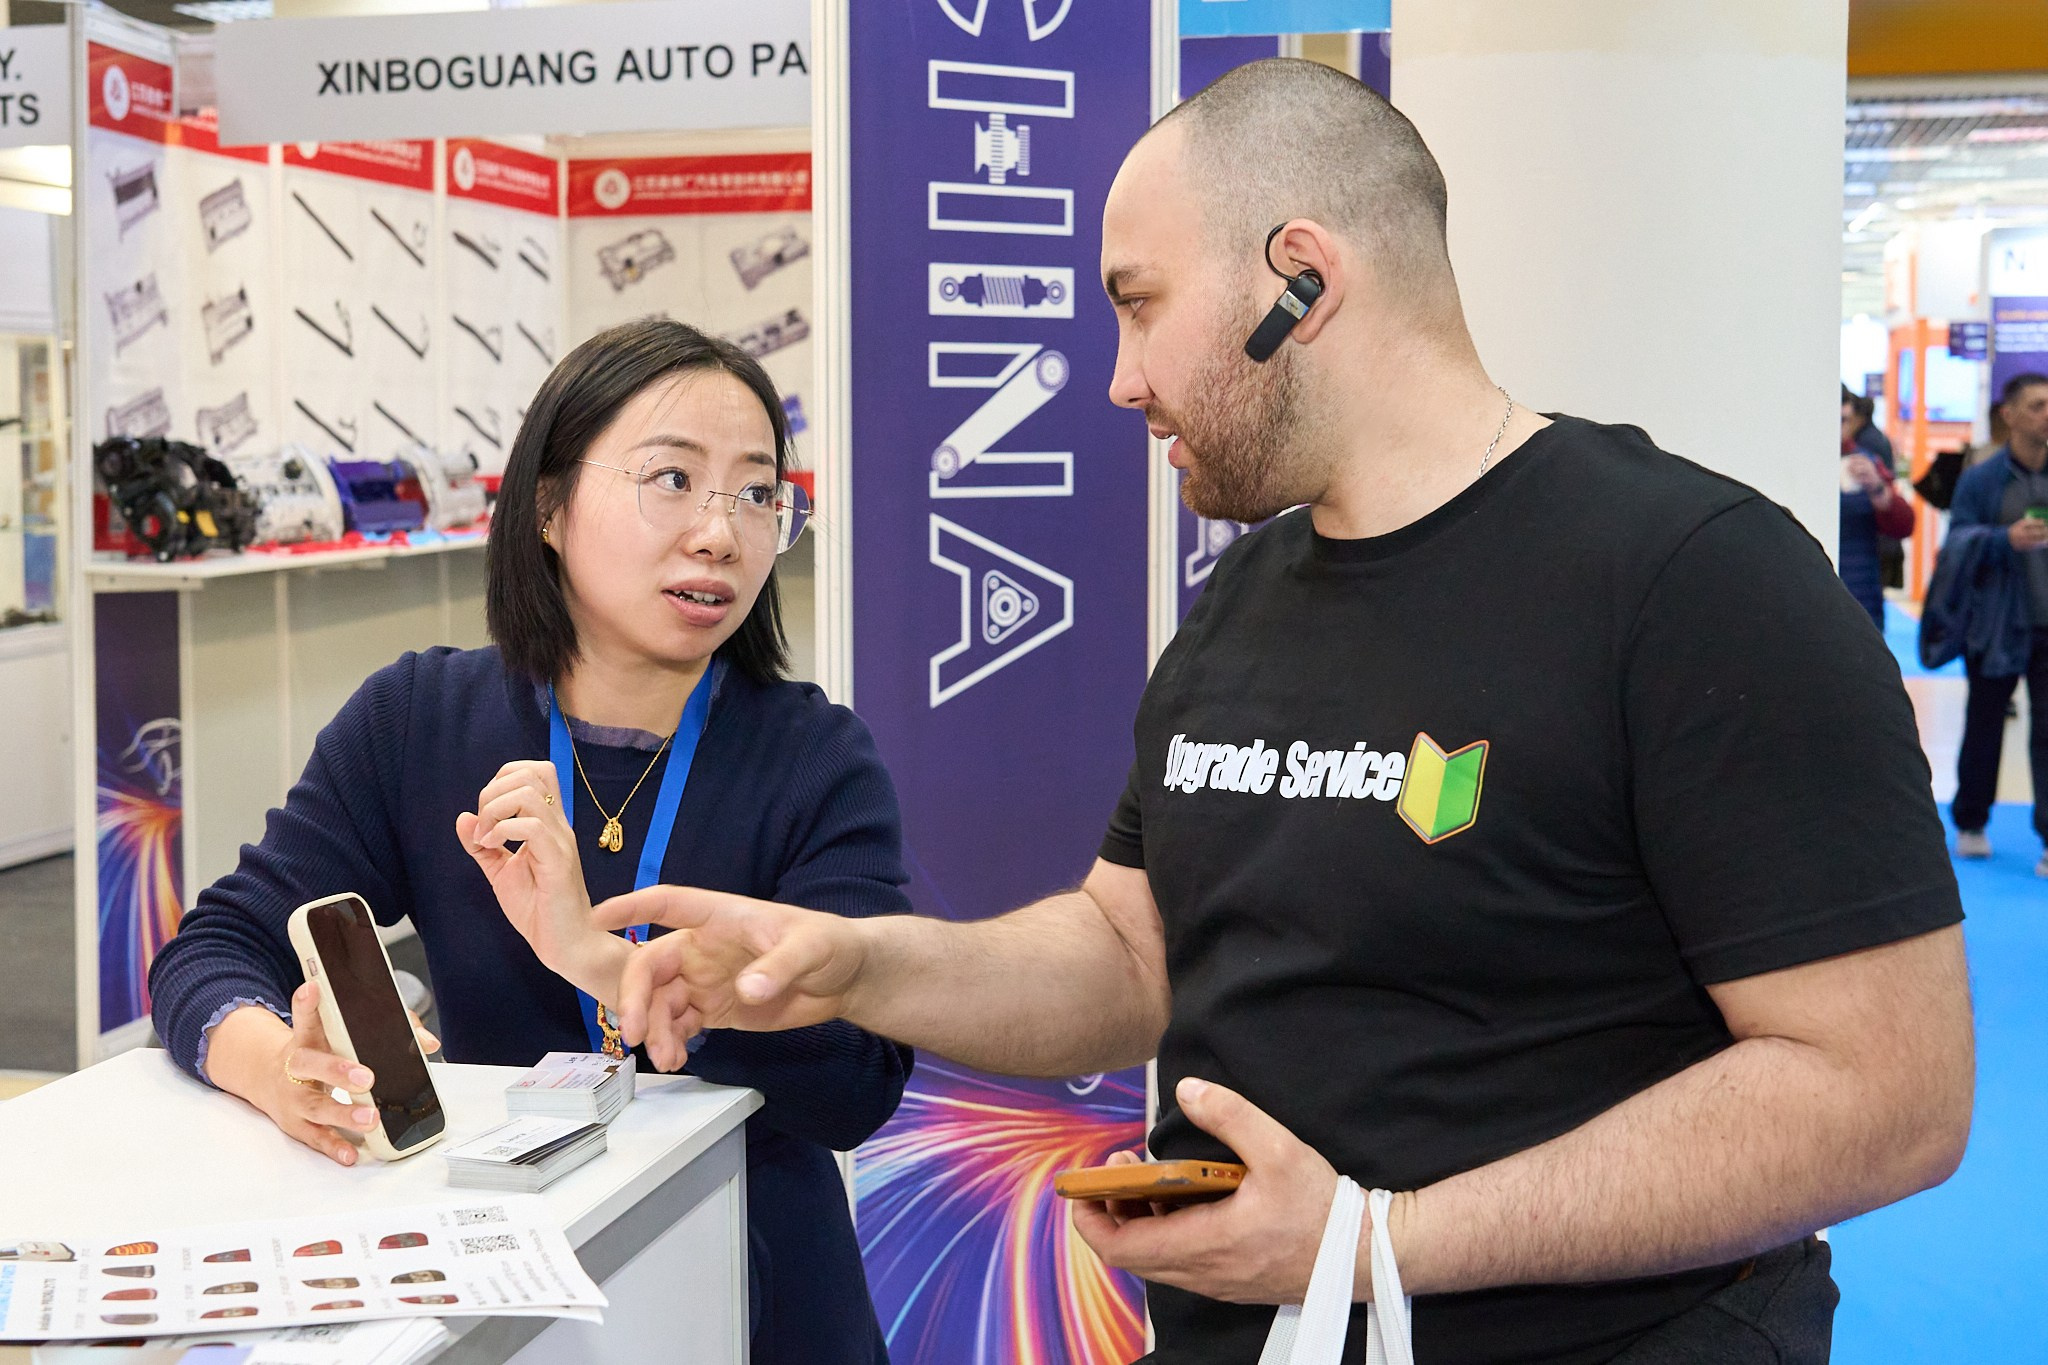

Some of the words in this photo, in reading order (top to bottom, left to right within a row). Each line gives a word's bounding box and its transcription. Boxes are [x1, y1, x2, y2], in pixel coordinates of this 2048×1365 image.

[317, 50, 597, 96] XINBOGUANG
[616, 44, 734, 83] AUTO
[1163, 733, 1280, 794] Upgrade
[1279, 740, 1406, 801] Service
